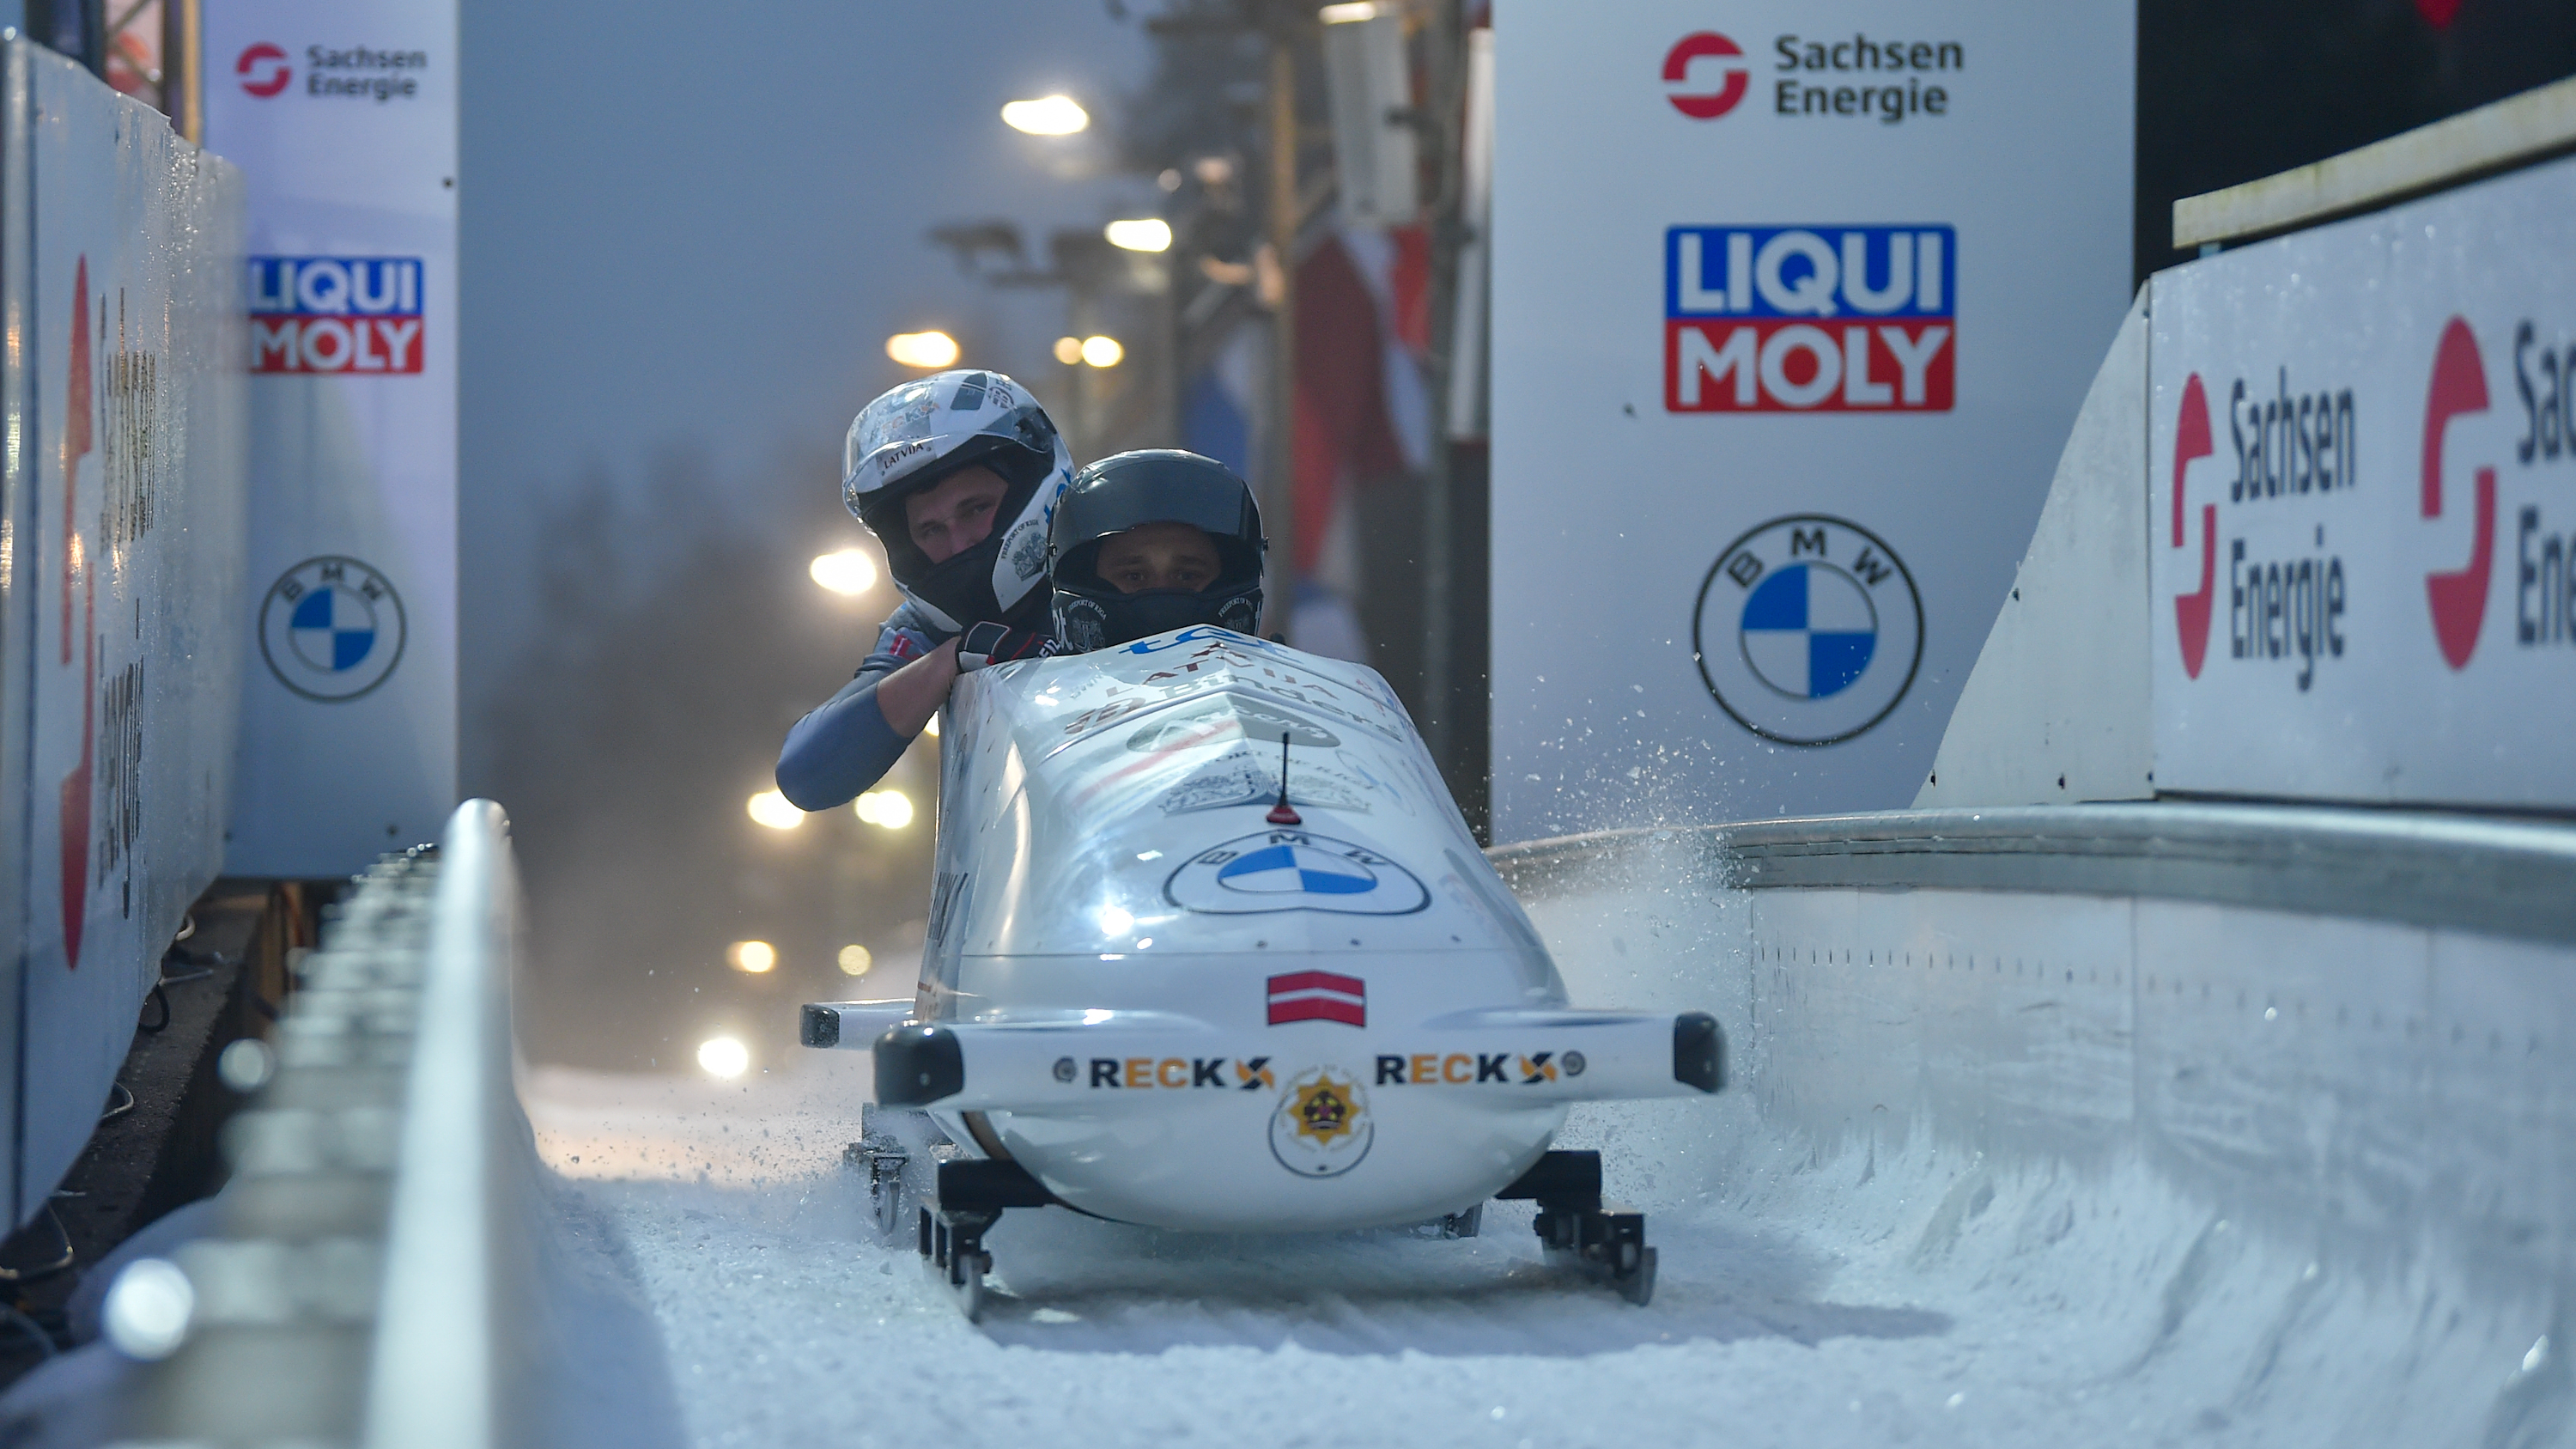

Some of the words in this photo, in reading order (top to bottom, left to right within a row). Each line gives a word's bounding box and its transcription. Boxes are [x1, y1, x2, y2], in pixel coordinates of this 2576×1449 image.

[306, 43, 428, 69] Sachsen
[1774, 33, 1964, 71] Sachsen
[307, 73, 418, 103] Energie
[1775, 77, 1947, 124] Energie
[251, 261, 416, 313] LIQUI
[1679, 229, 1943, 317] LIQUI
[251, 319, 419, 369] MOLY
[1679, 325, 1951, 408] MOLY
[2231, 364, 2356, 505] Sachsen
[884, 443, 924, 470] LATVIJA
[1726, 526, 1893, 589] BMW
[281, 562, 382, 602] BMW
[2232, 521, 2347, 692] Energie
[1197, 832, 1390, 866] BMW
[1089, 1057, 1227, 1088] RECK
[1376, 1052, 1509, 1085] RECK
